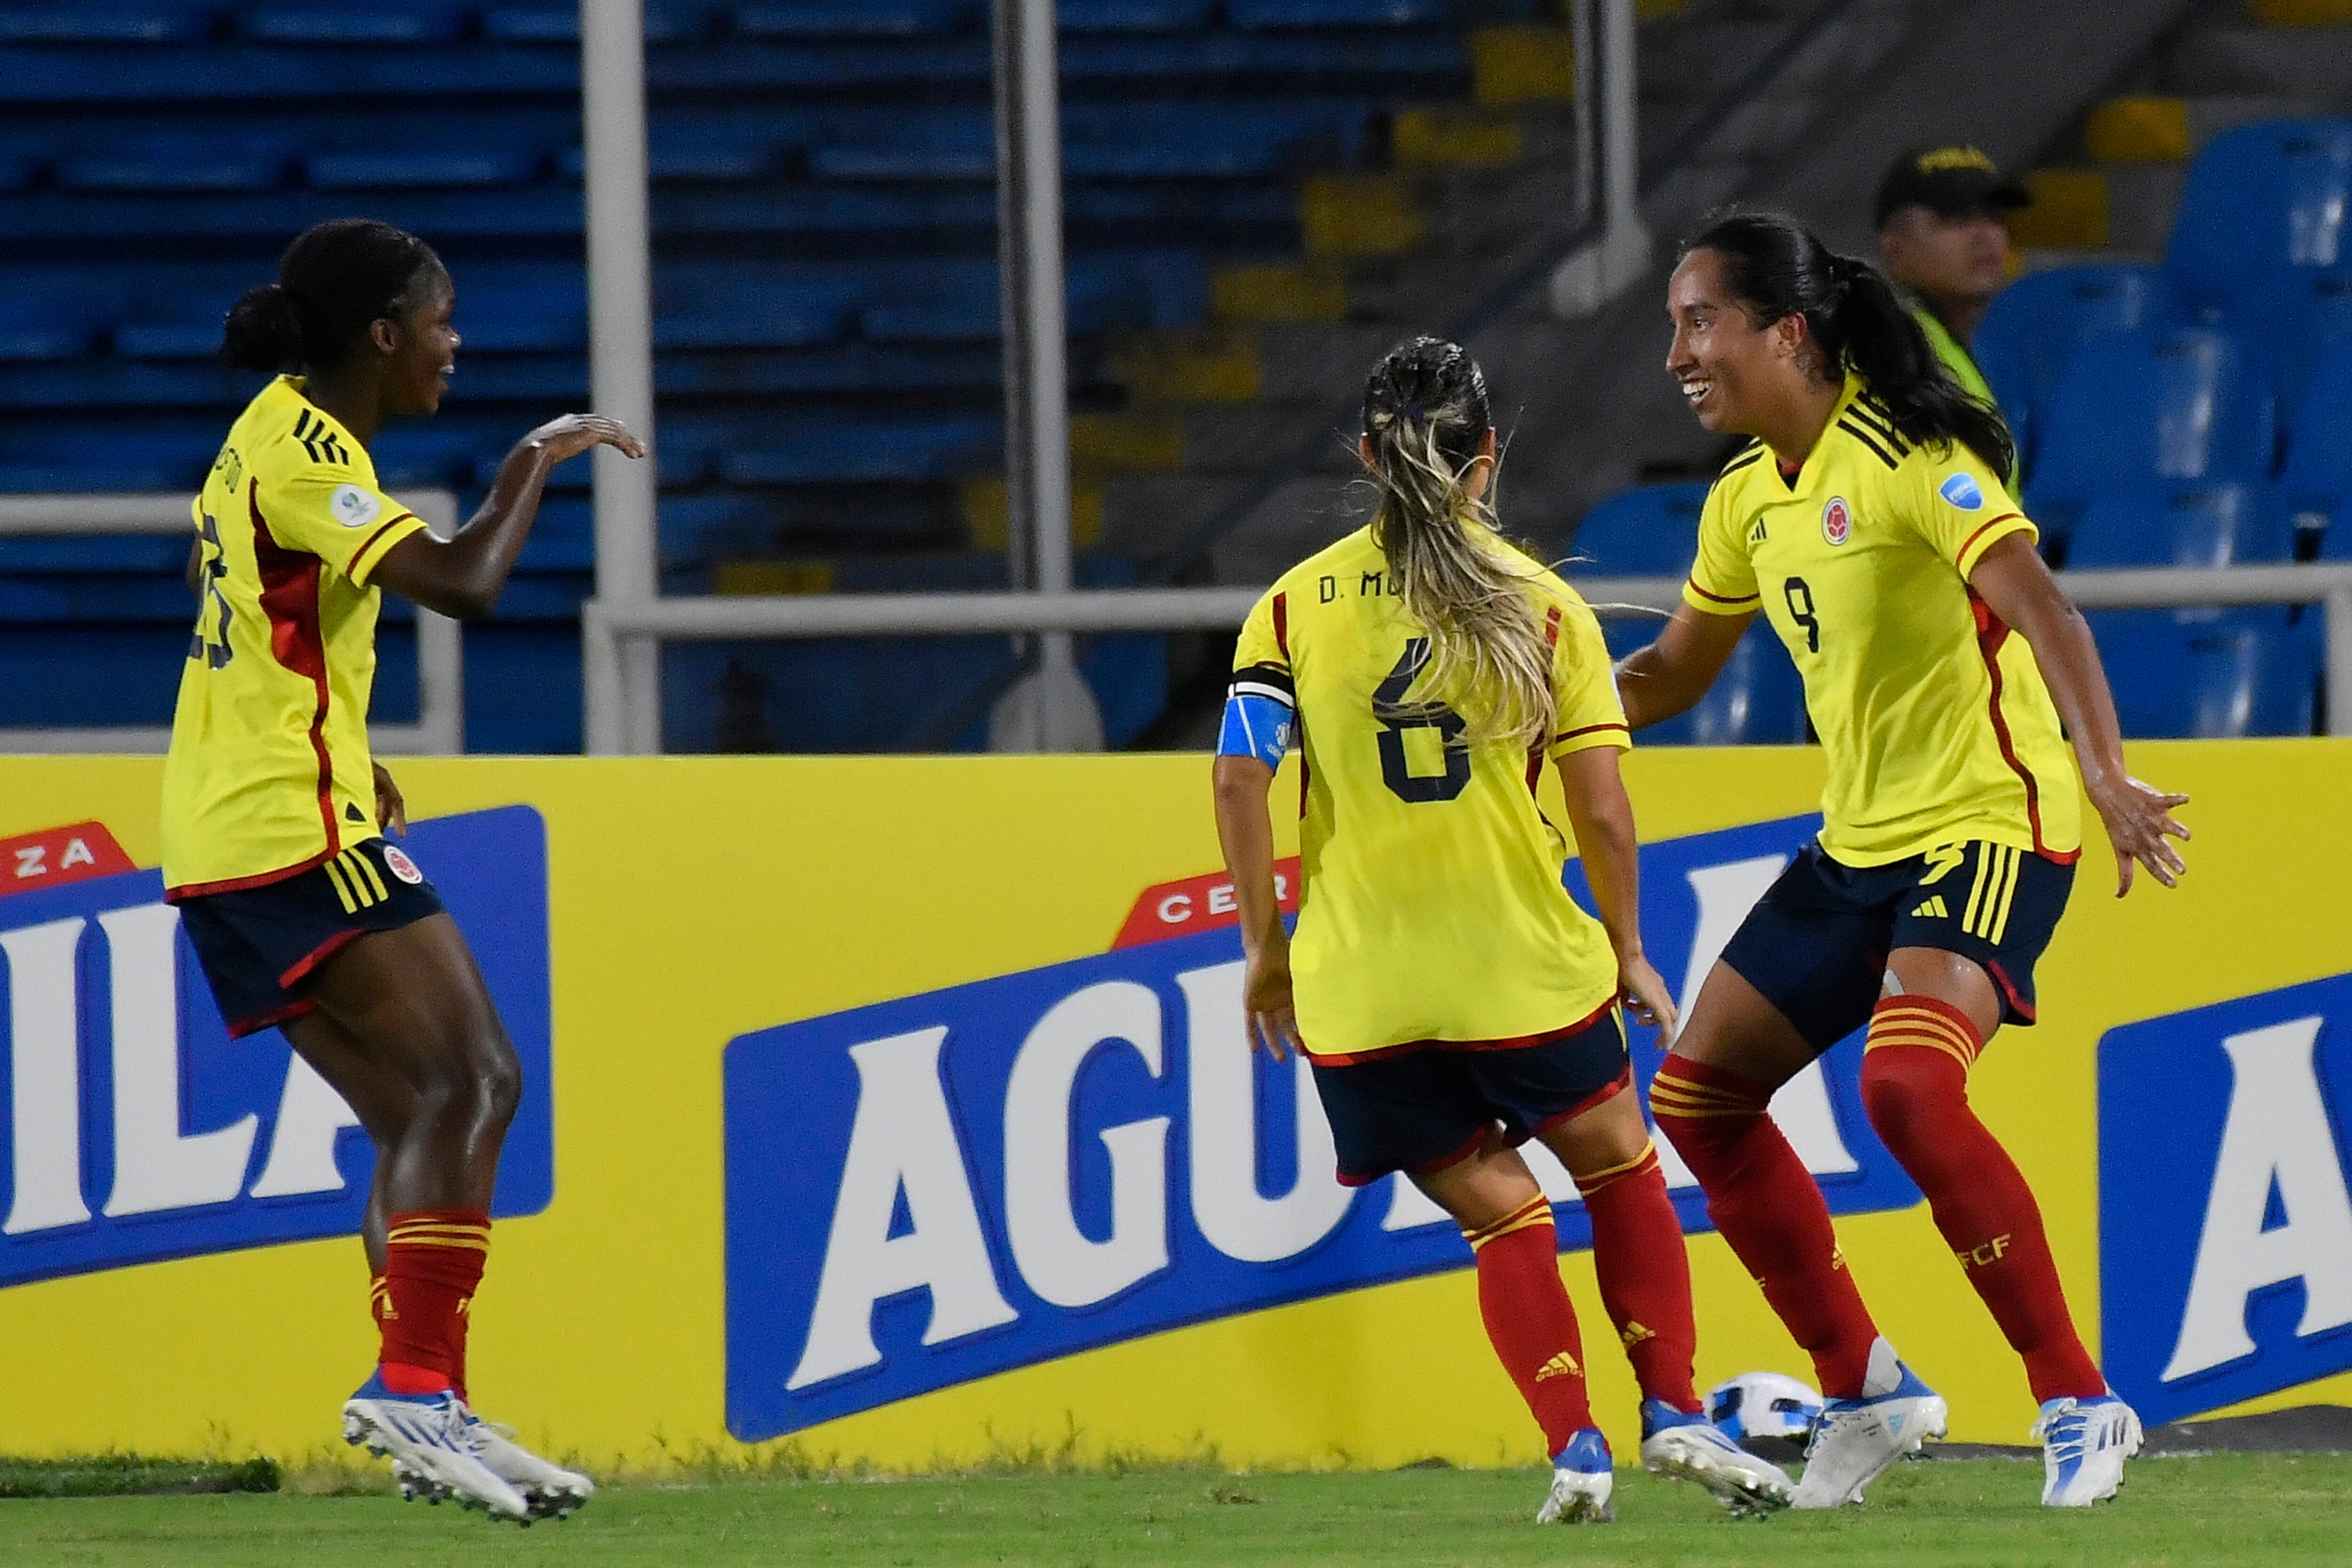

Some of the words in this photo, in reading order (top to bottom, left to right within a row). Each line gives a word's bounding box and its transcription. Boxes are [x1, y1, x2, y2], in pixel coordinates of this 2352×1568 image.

[1319, 575, 1345, 604] D.
[1784, 576, 1819, 653] 9
[1371, 637, 1472, 803] 6
[2160, 1015, 2352, 1382] A
